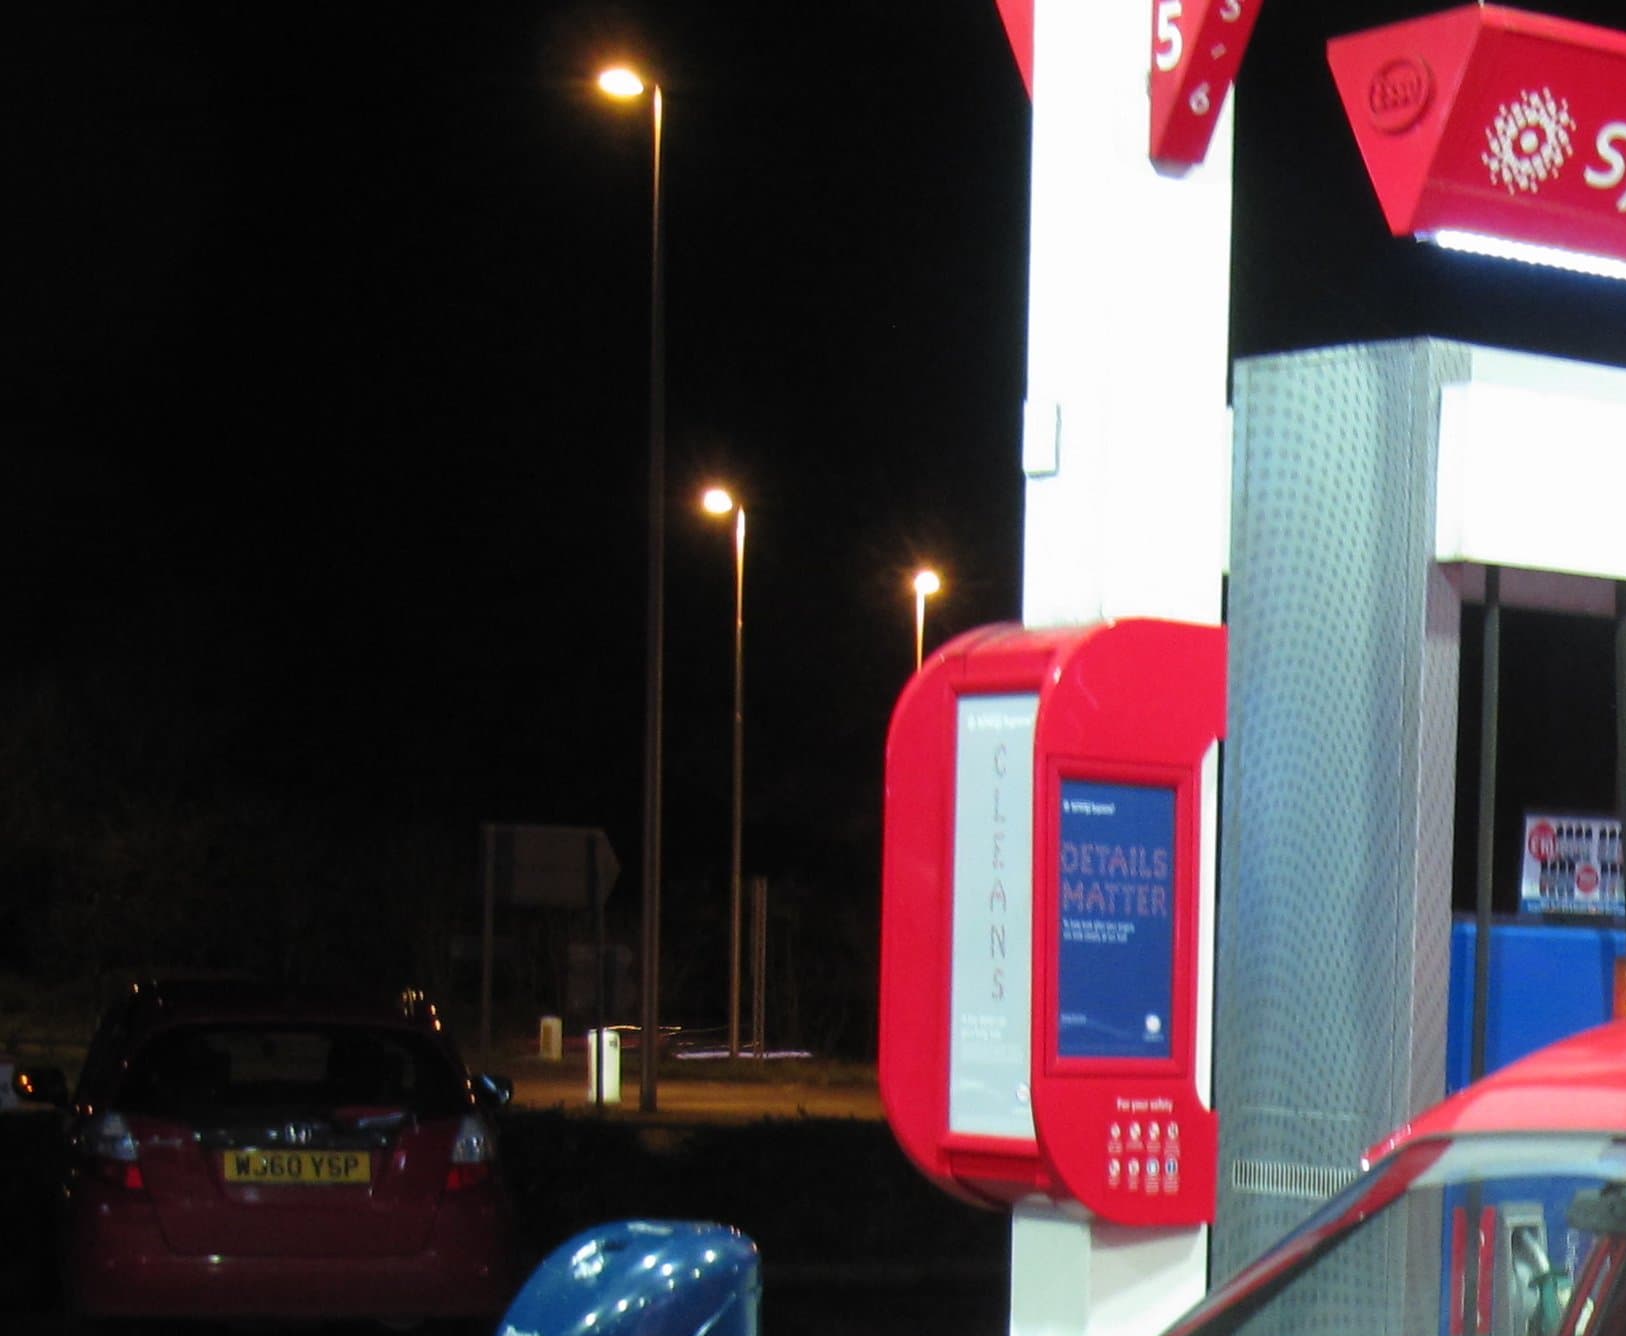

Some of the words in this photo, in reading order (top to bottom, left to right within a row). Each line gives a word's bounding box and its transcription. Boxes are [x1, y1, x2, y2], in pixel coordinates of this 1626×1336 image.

[1156, 0, 1183, 73] 5
[1060, 840, 1169, 880] DETAILS
[1062, 877, 1168, 918] MATTER
